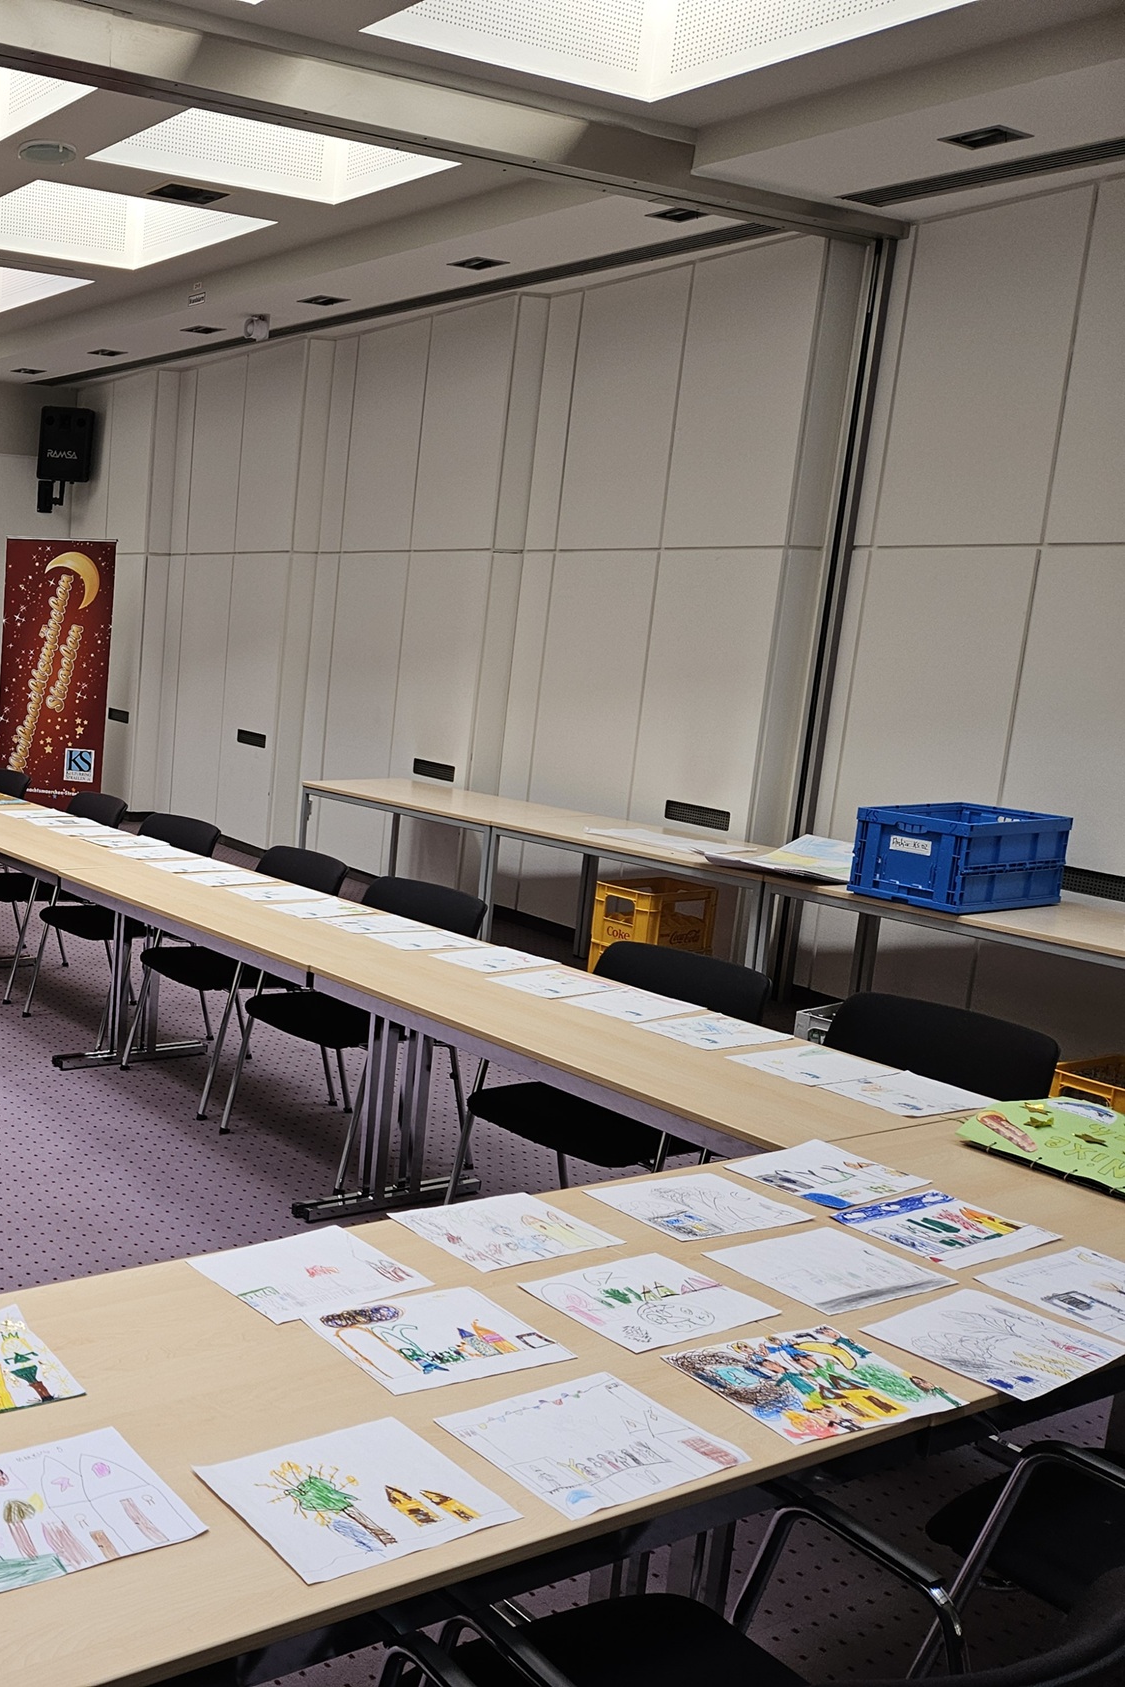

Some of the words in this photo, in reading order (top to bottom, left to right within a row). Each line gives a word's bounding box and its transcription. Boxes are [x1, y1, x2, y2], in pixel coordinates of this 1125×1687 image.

[46, 448, 78, 460] RAMSA
[6, 573, 75, 774] Weihnachtsmärchen
[45, 623, 84, 713] Straelen
[67, 750, 92, 772] KS
[606, 925, 631, 941] Coke
